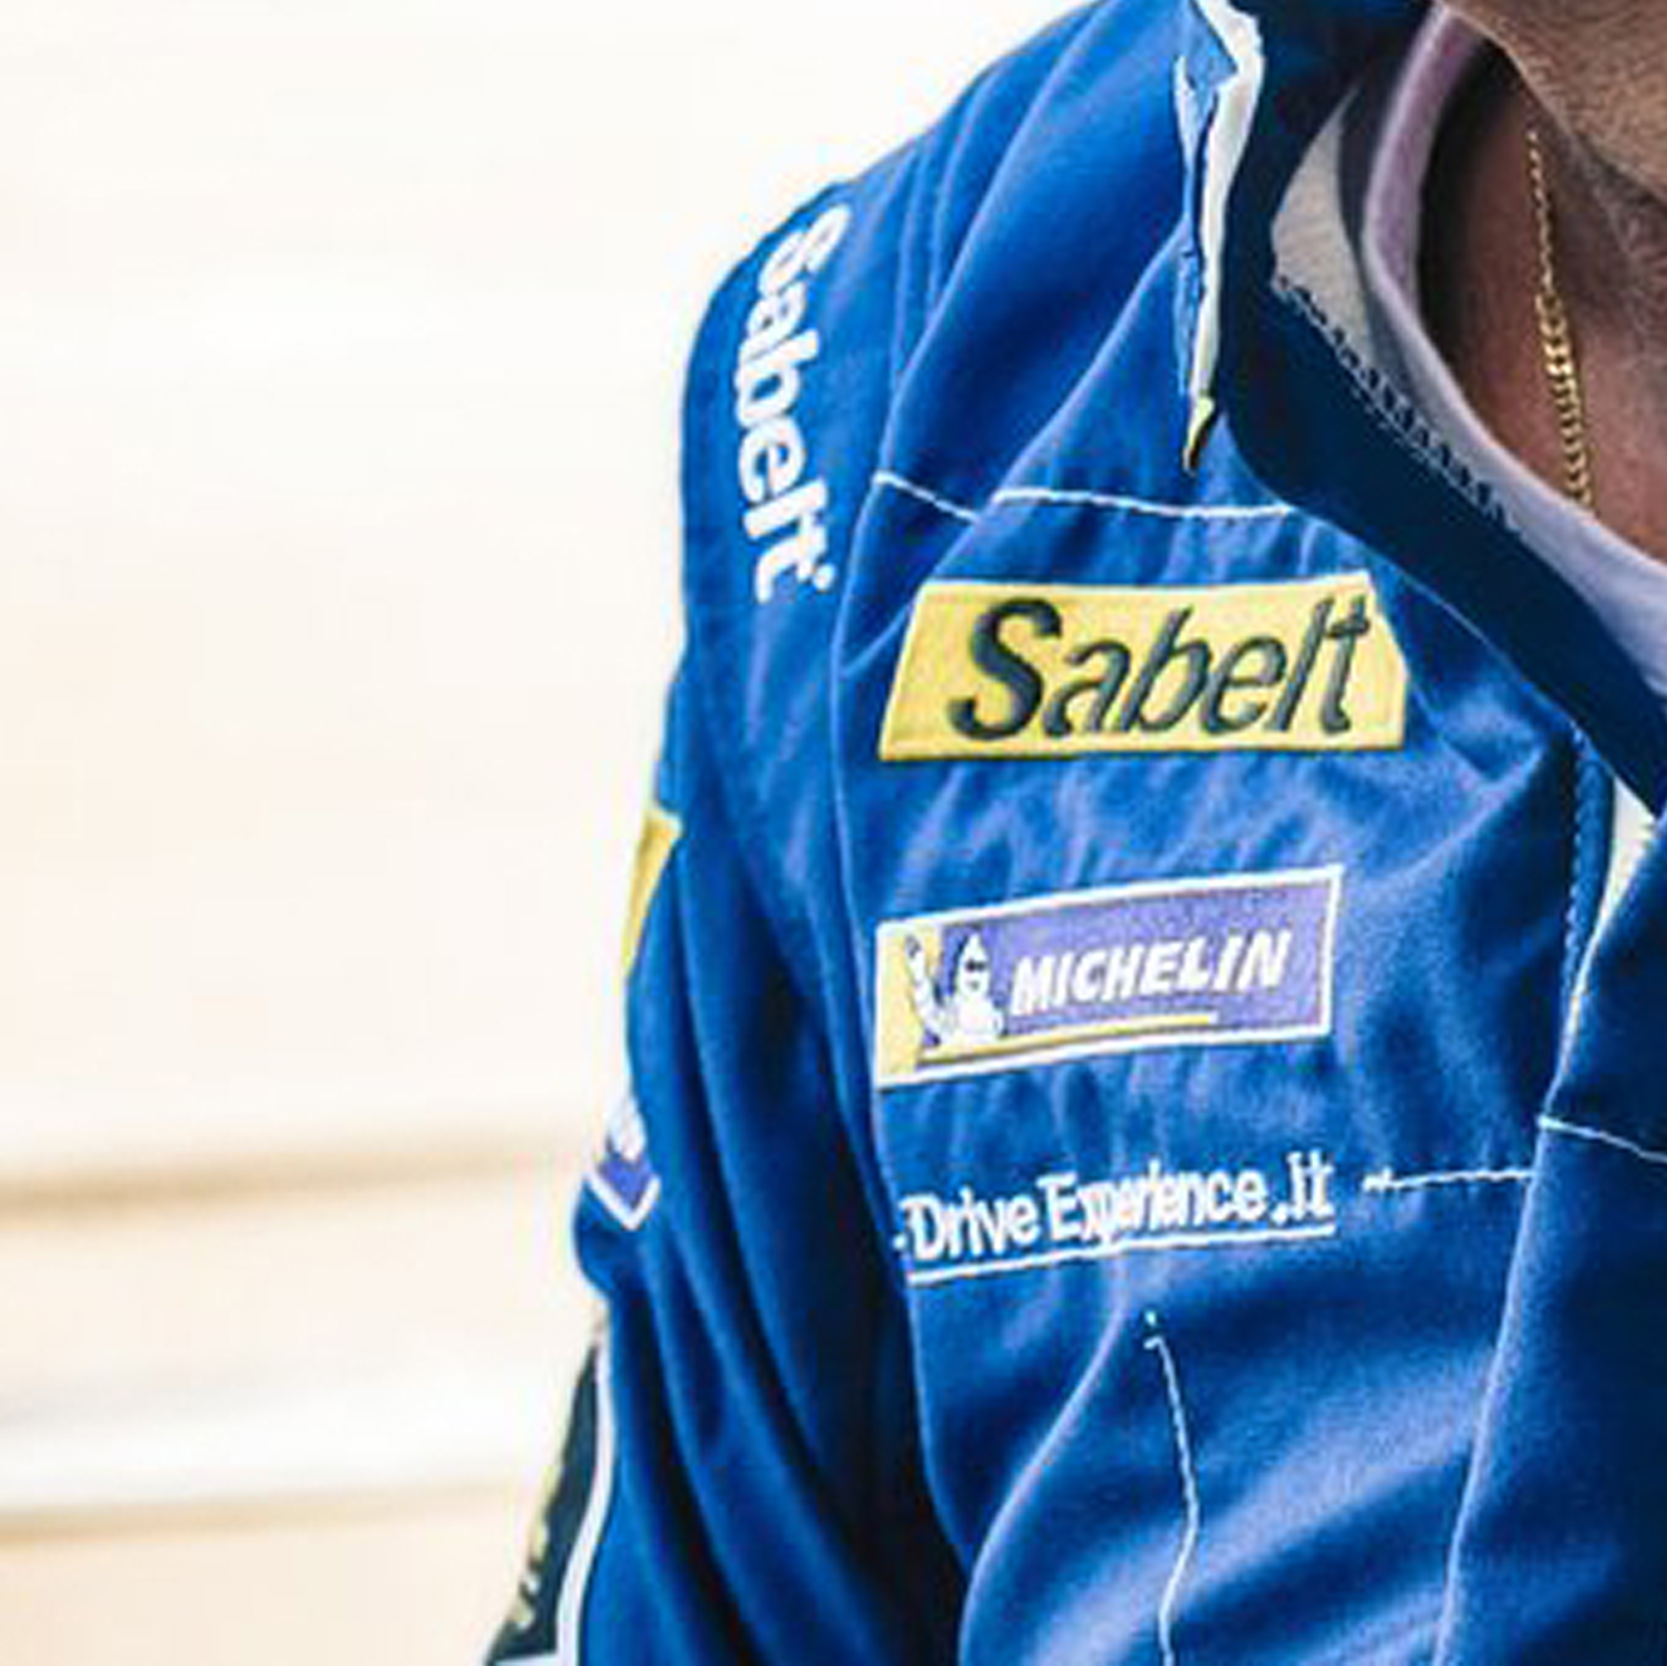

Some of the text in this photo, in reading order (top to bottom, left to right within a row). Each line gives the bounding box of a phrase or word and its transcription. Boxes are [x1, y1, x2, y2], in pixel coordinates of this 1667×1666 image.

[736, 205, 850, 604] Sabelt
[947, 592, 1370, 740] Sabelt
[1010, 929, 1293, 1016] MICHELIN
